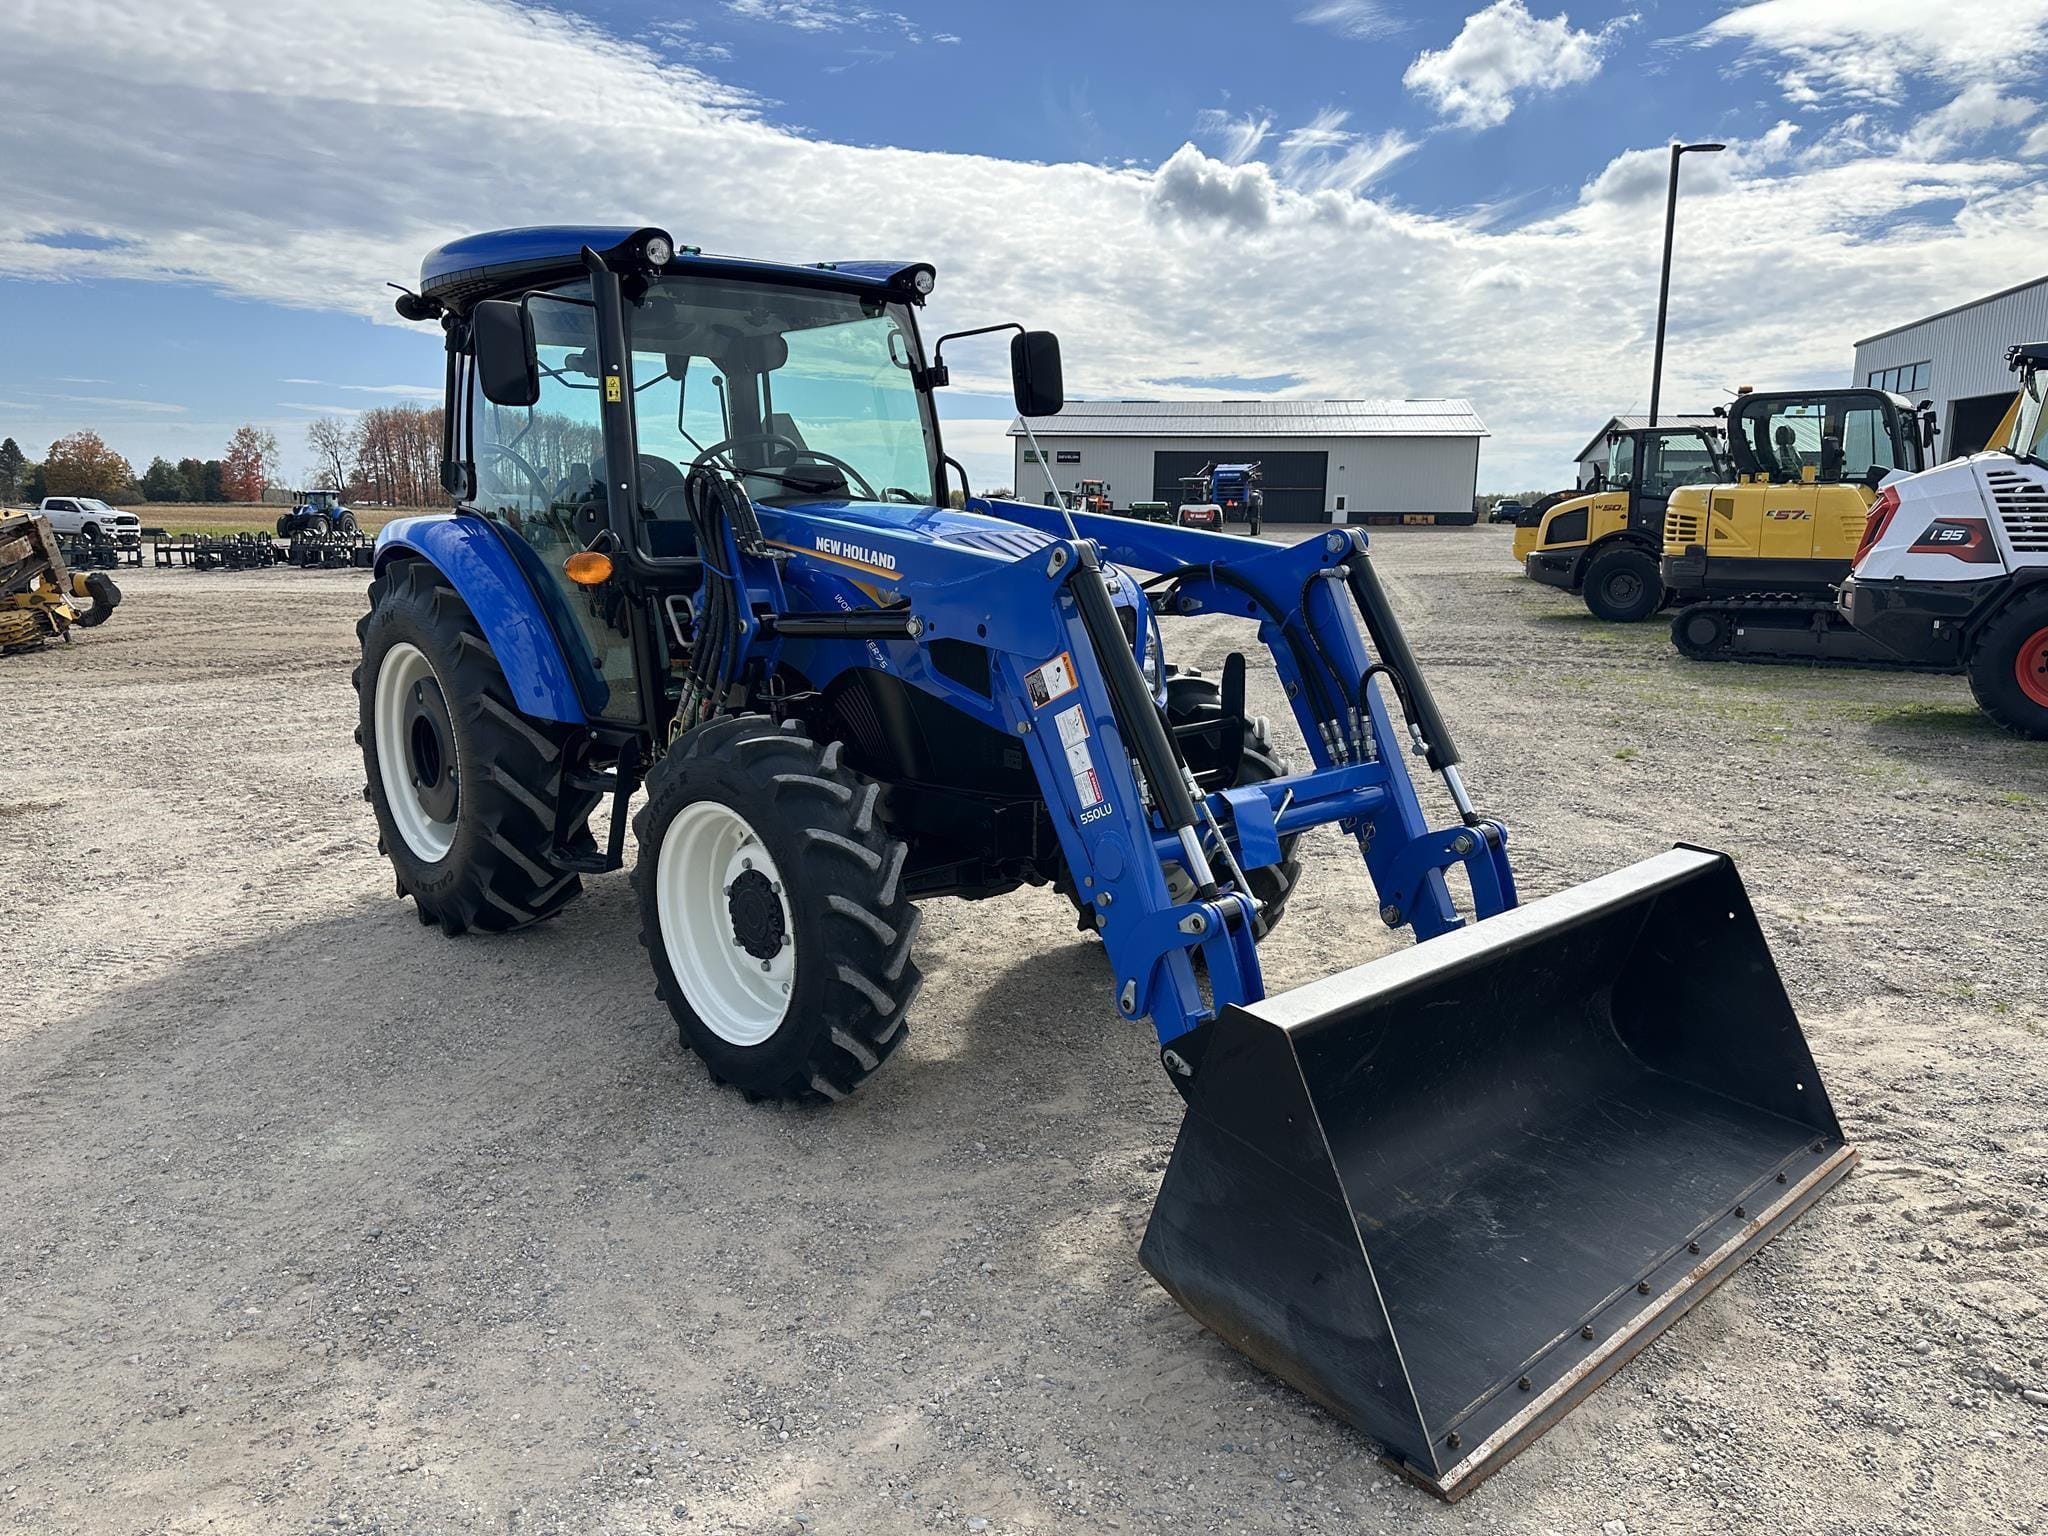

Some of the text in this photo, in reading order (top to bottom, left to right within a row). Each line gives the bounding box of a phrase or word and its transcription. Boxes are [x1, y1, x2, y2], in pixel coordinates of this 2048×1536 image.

[815, 536, 896, 570] NEW HOLLAND
[1080, 803, 1112, 825] 550LU
